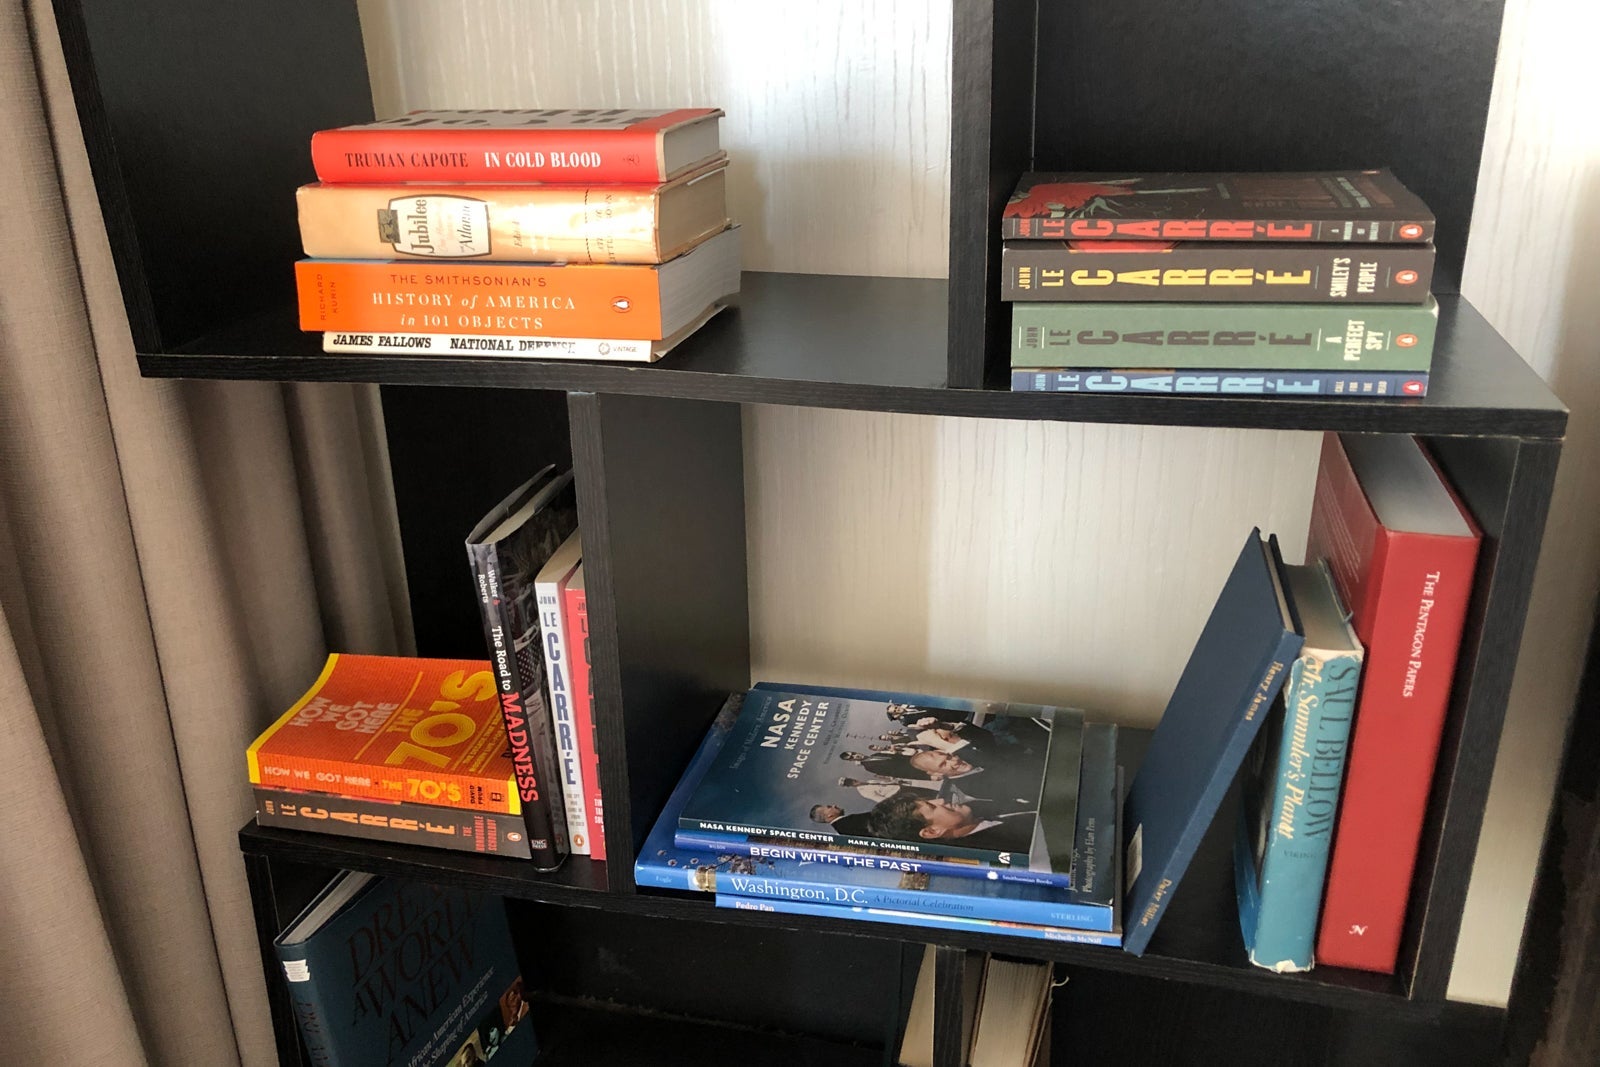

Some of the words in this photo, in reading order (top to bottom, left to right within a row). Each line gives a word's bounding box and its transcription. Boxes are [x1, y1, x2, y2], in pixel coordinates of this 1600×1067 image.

[345, 152, 404, 168] TRUMAN
[411, 152, 469, 168] CAPOTE
[484, 151, 500, 168] IN
[505, 151, 545, 168] COLD
[550, 151, 602, 168] BLOOD
[407, 199, 435, 254] Jubilee
[1042, 219, 1065, 237] LE
[390, 274, 418, 285] THE
[425, 275, 547, 287] SMITHSONIAN'S
[1018, 266, 1031, 290] JOHN
[1042, 269, 1065, 287] LE
[1330, 257, 1352, 298] SMILEY'S
[1357, 261, 1378, 293] PEOPLE
[316, 273, 327, 321] RICHARD
[329, 281, 338, 314] KURIN
[372, 292, 453, 307] HISTORY
[461, 294, 478, 309] of
[485, 295, 576, 310] AMERICA
[400, 313, 416, 326] in
[424, 314, 449, 327] 101
[458, 315, 543, 329] OBJECTS
[333, 334, 373, 346] JAMES
[378, 335, 432, 348] FALLOWS
[450, 337, 514, 351] NATIONAL
[1026, 327, 1038, 349] JOHN
[1049, 329, 1071, 346] LE
[1325, 336, 1343, 344] A
[1343, 319, 1365, 362] PERFECT
[1365, 330, 1384, 350] SPY
[1035, 373, 1046, 391] JOHN
[1057, 374, 1080, 392] LE
[543, 612, 558, 628] LE
[491, 625, 504, 648] The
[496, 649, 512, 678] Road
[502, 679, 511, 691] to
[1260, 660, 1284, 692] Henry
[1245, 692, 1267, 720] James
[1320, 664, 1357, 730] SAUL
[289, 697, 332, 727] HOW
[320, 704, 351, 723] WE
[335, 701, 375, 731] GOT
[355, 702, 399, 734] HERE
[386, 708, 425, 733] THE
[760, 699, 797, 748] NASA
[784, 700, 812, 750] KENNEDY
[1286, 690, 1320, 782] Sammler's
[501, 691, 539, 803] MADNESS
[787, 748, 811, 779] SPACE
[804, 702, 830, 746] CENTER
[264, 766, 290, 776] HOW
[294, 769, 310, 779] WE
[315, 772, 342, 783] GOT
[344, 775, 371, 788] HERE
[382, 779, 402, 791] THE
[406, 778, 462, 802] 70'S
[1303, 738, 1345, 840] BELLOW
[280, 803, 297, 817] LE
[1278, 782, 1305, 840] Planet
[700, 822, 724, 831] NASA
[726, 825, 767, 836] KENNEDY
[769, 829, 797, 839] SPACE
[799, 832, 834, 843] CENTER
[880, 842, 920, 852] CHAMBERS
[750, 847, 796, 860] BEGIN
[800, 852, 838, 864] WITH
[842, 856, 875, 868] THE
[880, 860, 922, 872] PAST
[731, 878, 830, 902] Washington,
[834, 887, 868, 905] D.C.
[1152, 878, 1173, 902] Daisy
[735, 902, 758, 911] Pedro
[874, 895, 881, 903] A
[882, 896, 920, 907] Pictorial
[922, 898, 974, 912] Celebration
[1051, 912, 1094, 922] STERLING
